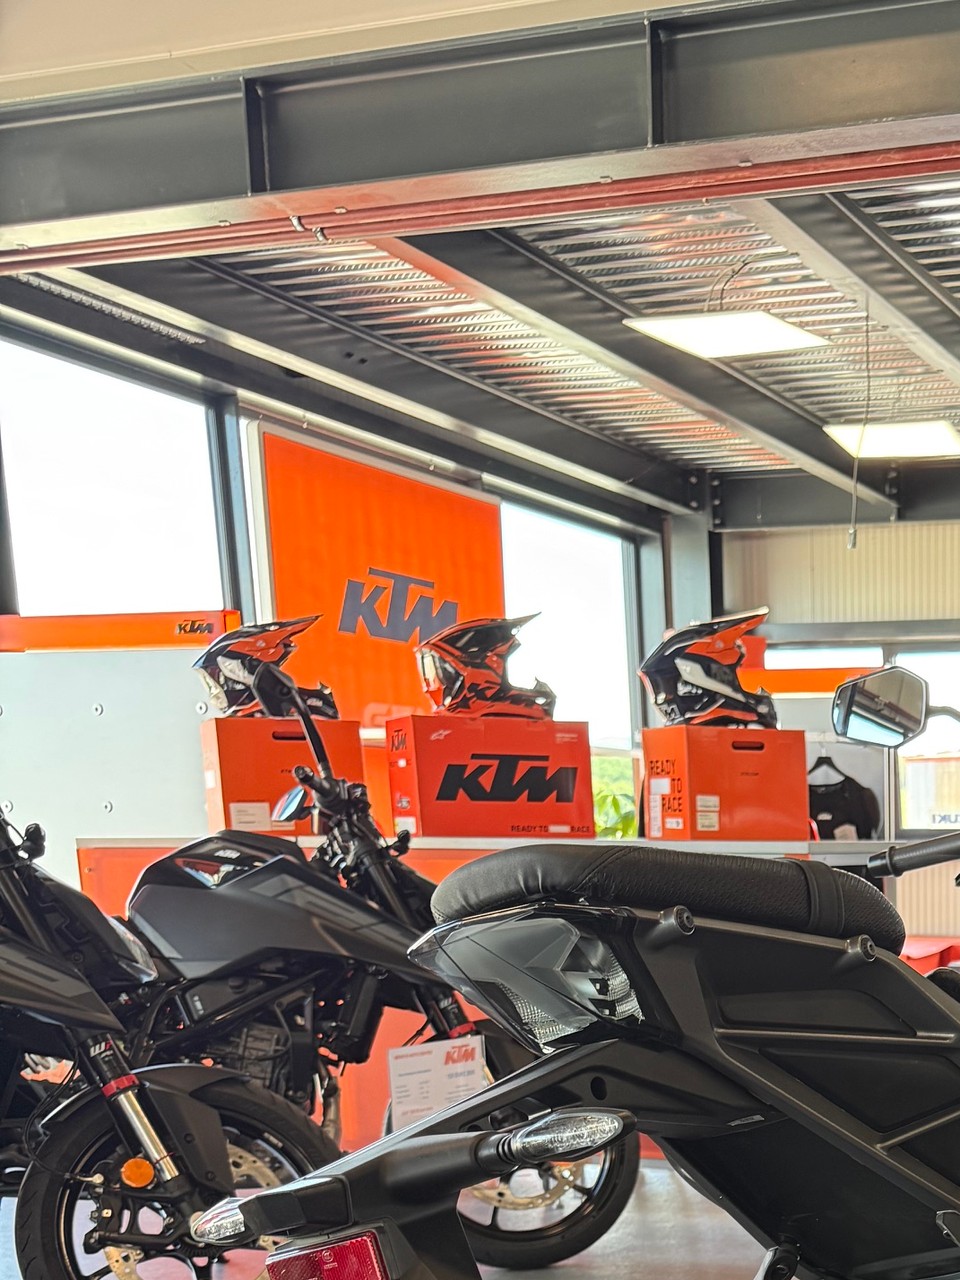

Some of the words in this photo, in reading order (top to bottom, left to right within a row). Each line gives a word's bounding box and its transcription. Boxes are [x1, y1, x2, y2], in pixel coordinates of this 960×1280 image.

[338, 567, 459, 644] KTM
[176, 619, 214, 634] KTM
[390, 728, 407, 752] KTM
[650, 759, 676, 775] READY
[436, 753, 578, 803] KTM
[671, 777, 683, 794] TO
[661, 797, 683, 813] RACE
[510, 825, 537, 833] READY
[537, 825, 549, 833] TO
[570, 825, 591, 833] RACE
[444, 1043, 477, 1066] KTM
